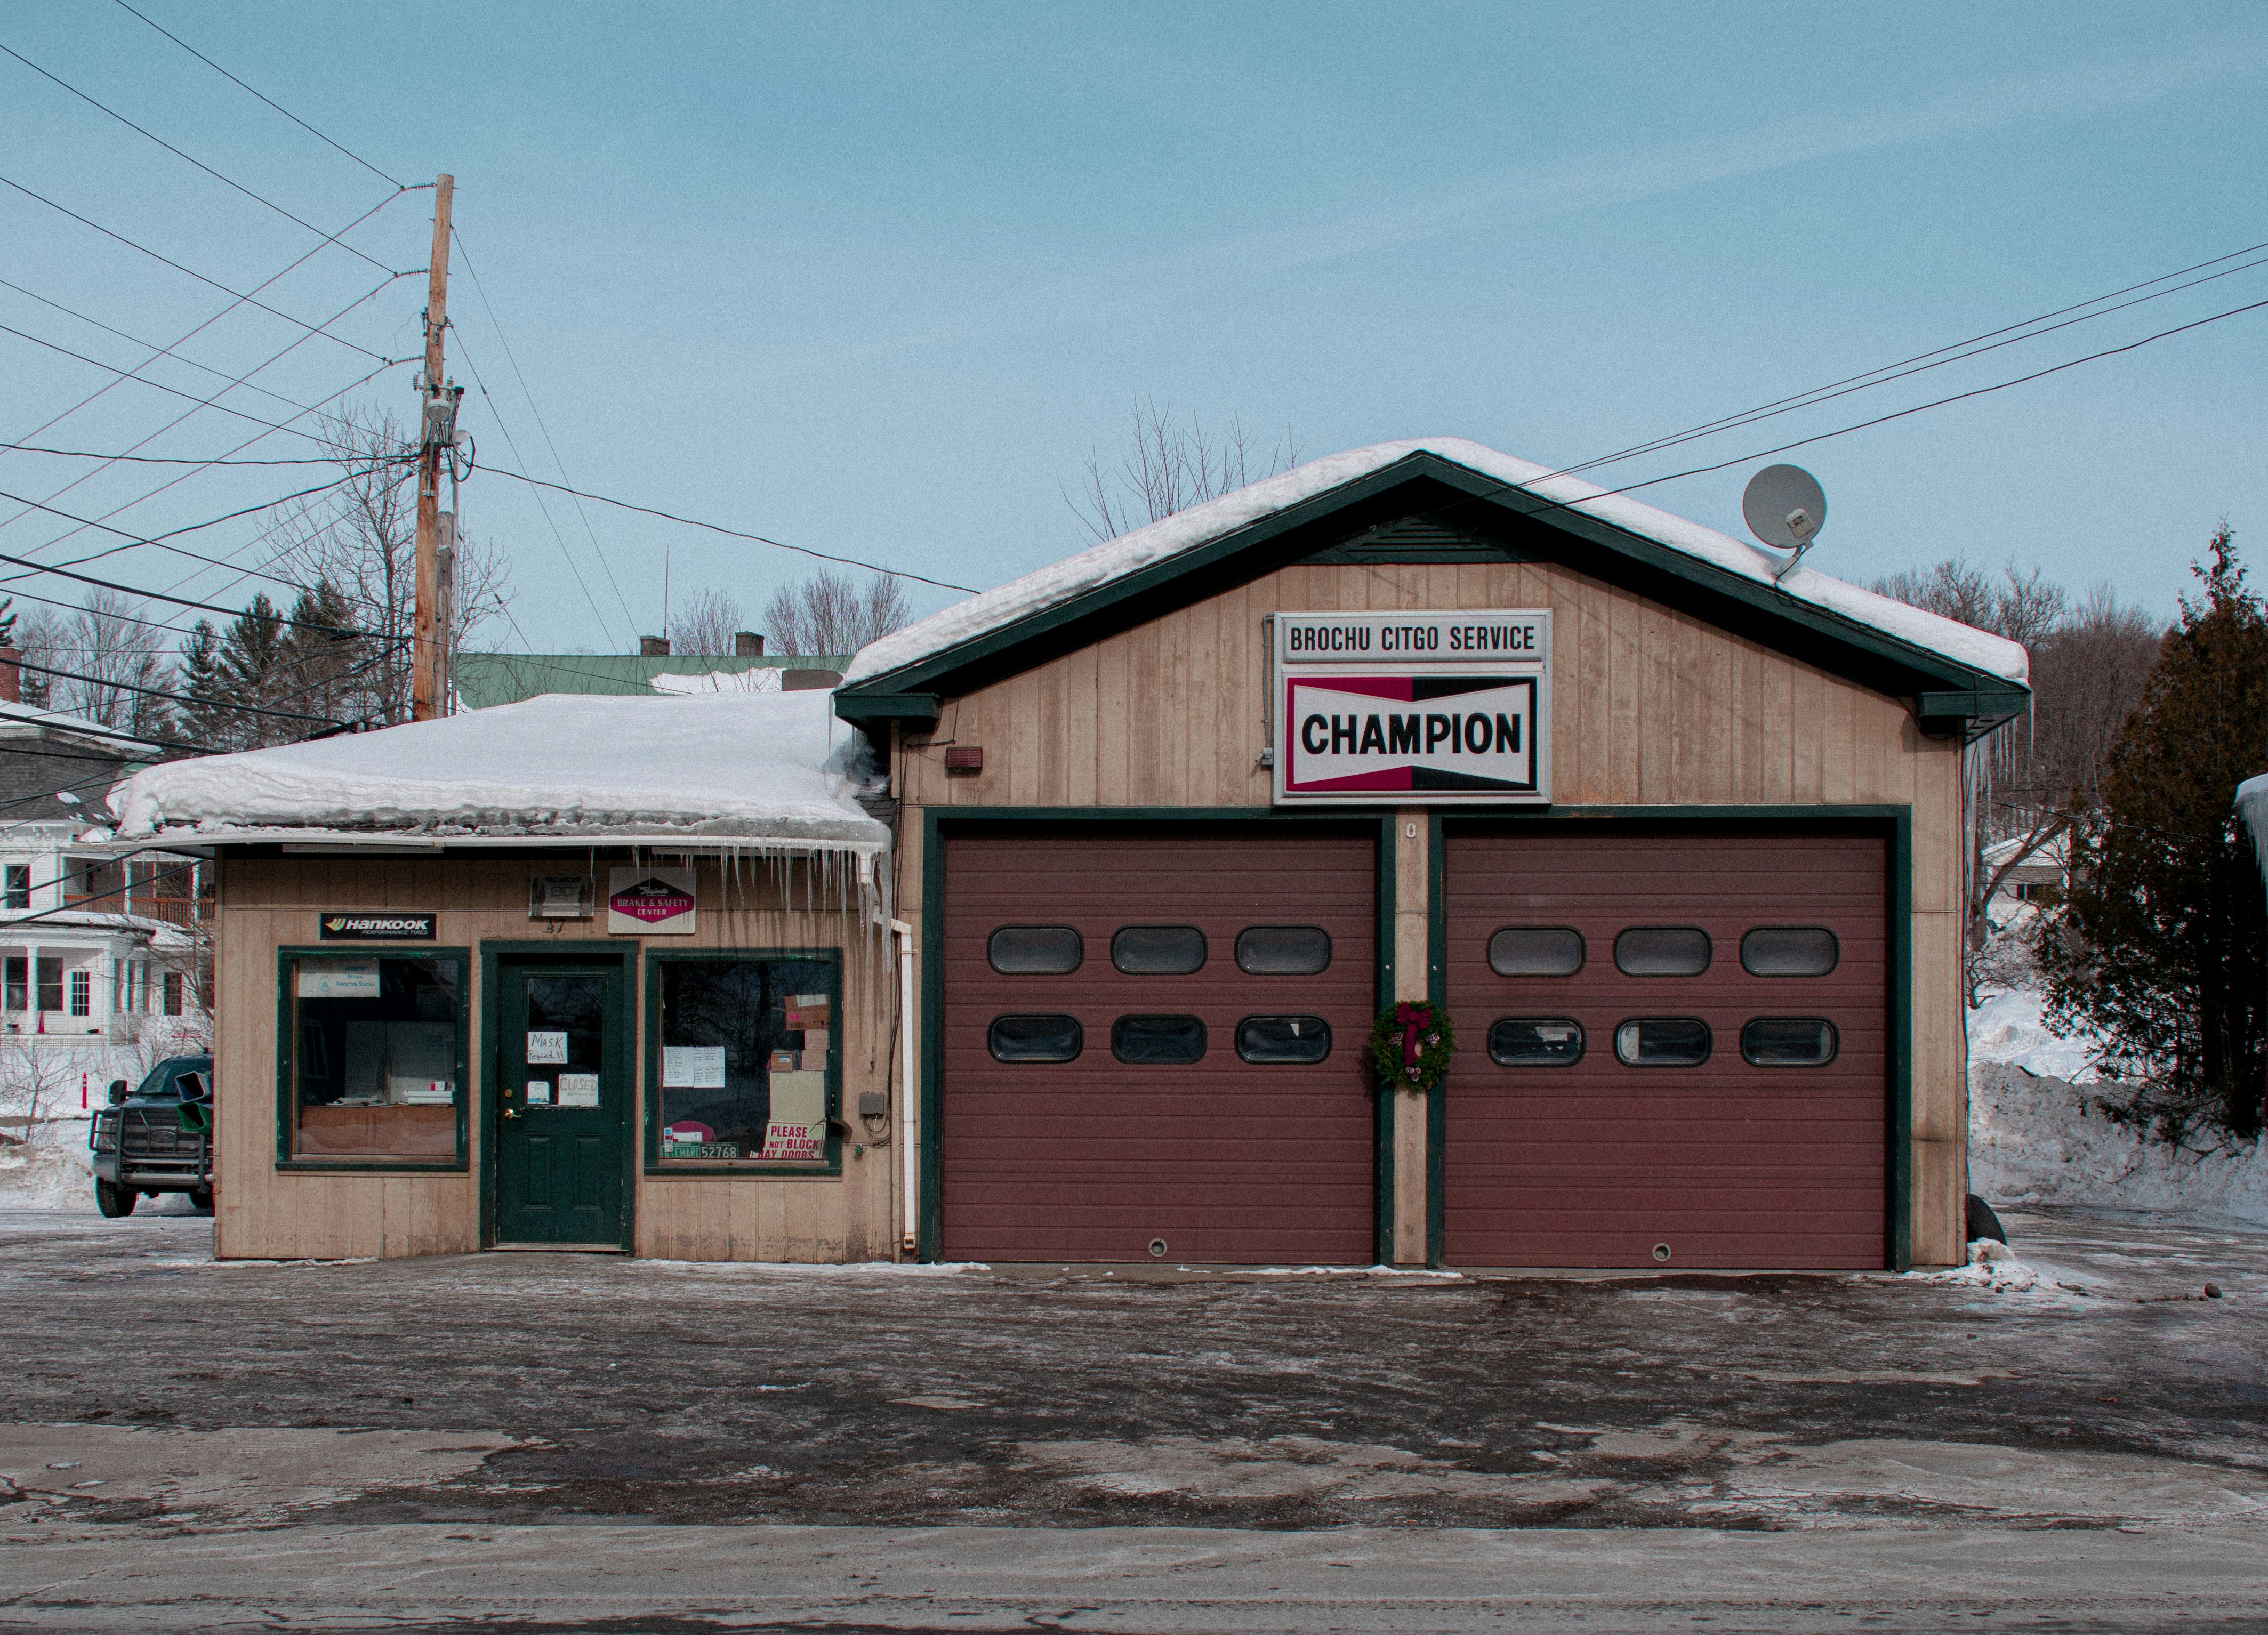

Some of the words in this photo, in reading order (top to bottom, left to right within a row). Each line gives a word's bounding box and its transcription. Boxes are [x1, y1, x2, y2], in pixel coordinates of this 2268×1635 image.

[1290, 627, 1370, 651] BROCHU
[1381, 626, 1438, 650] CITGO
[1450, 626, 1535, 650] SERVICE
[1301, 713, 1521, 754] CHAMPION
[531, 1033, 564, 1049] MASK
[559, 1077, 598, 1092] CLOSED
[770, 1125, 808, 1138] PLEASE
[786, 1139, 819, 1150] BLOCK
[701, 1147, 737, 1158] 52768
